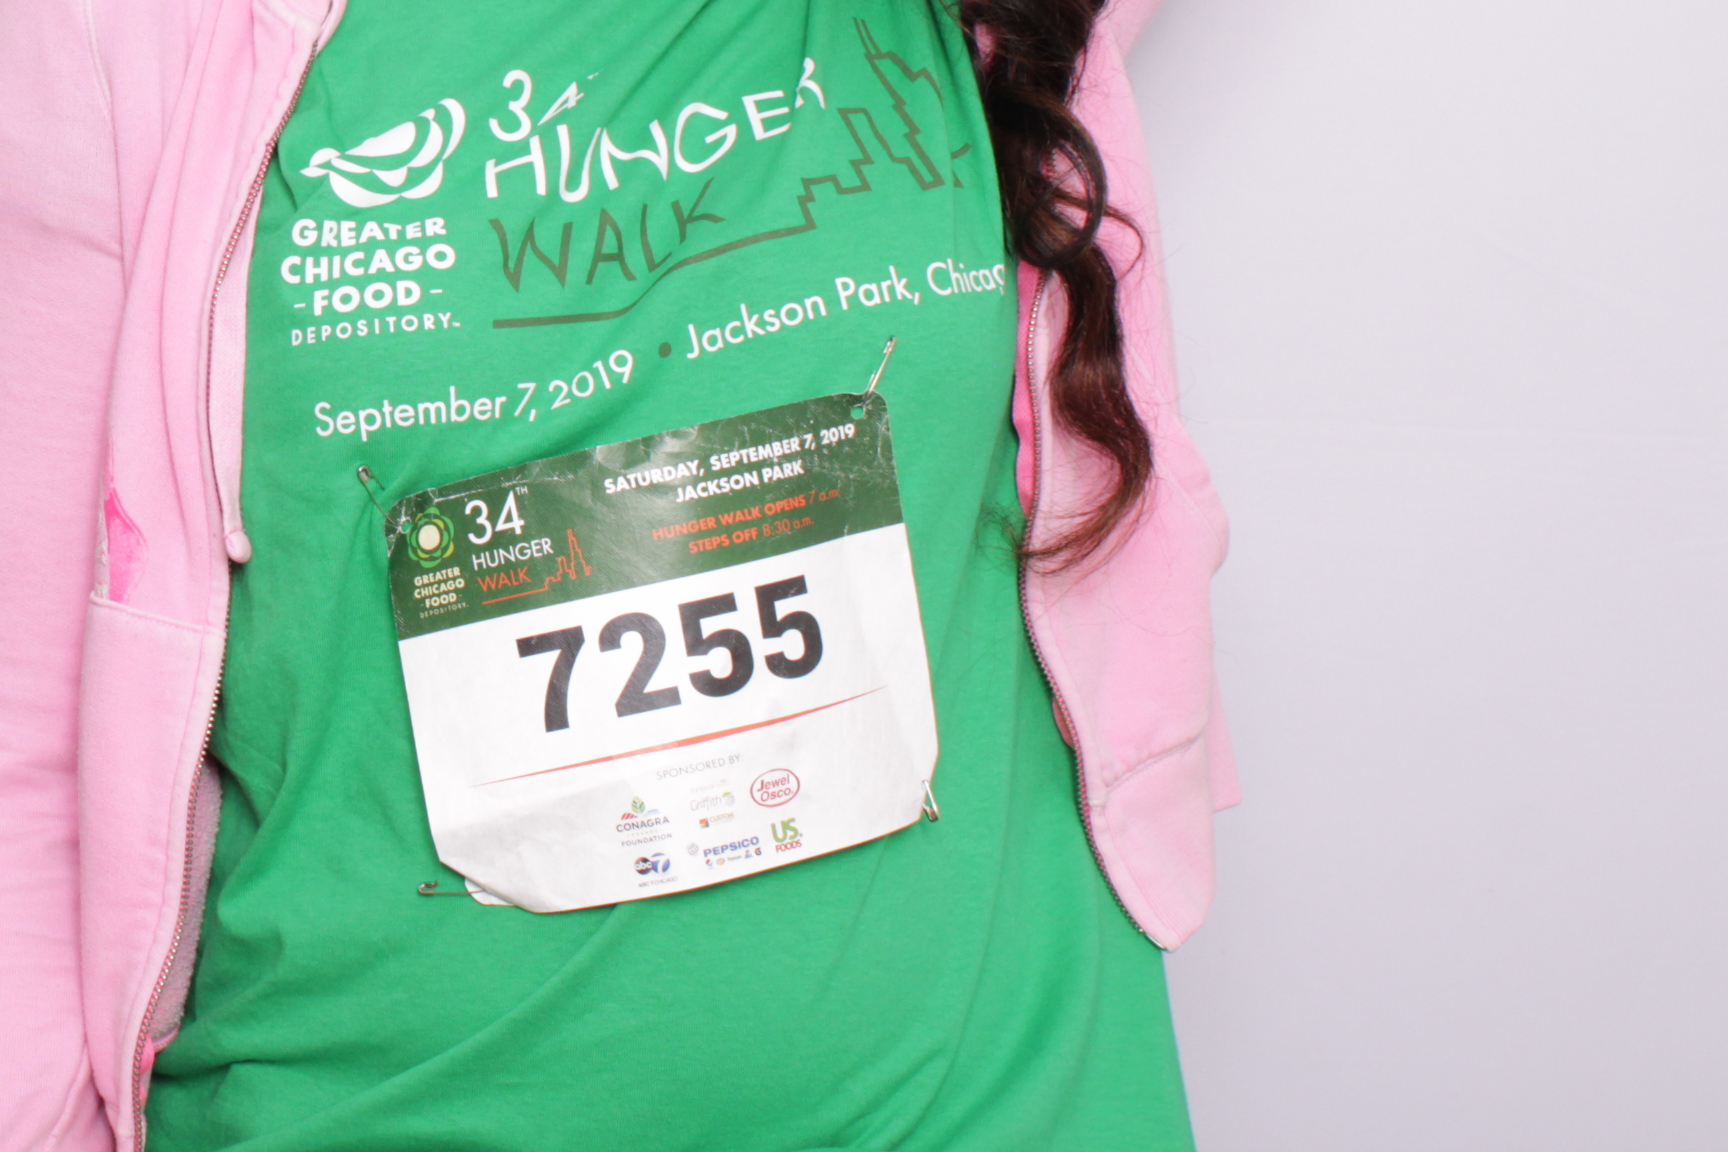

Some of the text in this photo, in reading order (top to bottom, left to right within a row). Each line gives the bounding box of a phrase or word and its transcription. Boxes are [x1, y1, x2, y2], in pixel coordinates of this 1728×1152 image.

[291, 216, 448, 248] GREATER
[489, 176, 726, 294] WALK
[280, 243, 456, 285] CHICAGO
[313, 280, 422, 317] FOOD
[314, 258, 1006, 442] September 7, 2019 Jackson Park, Chicag
[603, 423, 856, 494] SATURDAY, SEPTEMBER 7, 2019
[675, 460, 805, 503] JACKSON PARK
[651, 488, 841, 542] HUNGER WALK OPENS 7 a.m.
[688, 515, 815, 555] STEPS OFF 8:30 a.m.
[471, 537, 554, 571] HUNGER
[414, 566, 462, 587] GREATER
[414, 578, 465, 599] CHICAGO
[477, 566, 532, 593] WALK
[425, 592, 458, 609] FOOD
[515, 574, 824, 733] 7255
[655, 757, 726, 781] SPONSORED
[756, 773, 790, 793] Jewel
[615, 815, 671, 833] CONAGRA
[621, 832, 673, 848] FOUNDATION
[702, 835, 760, 858] PEPSICO
[775, 839, 803, 853] FOODS
